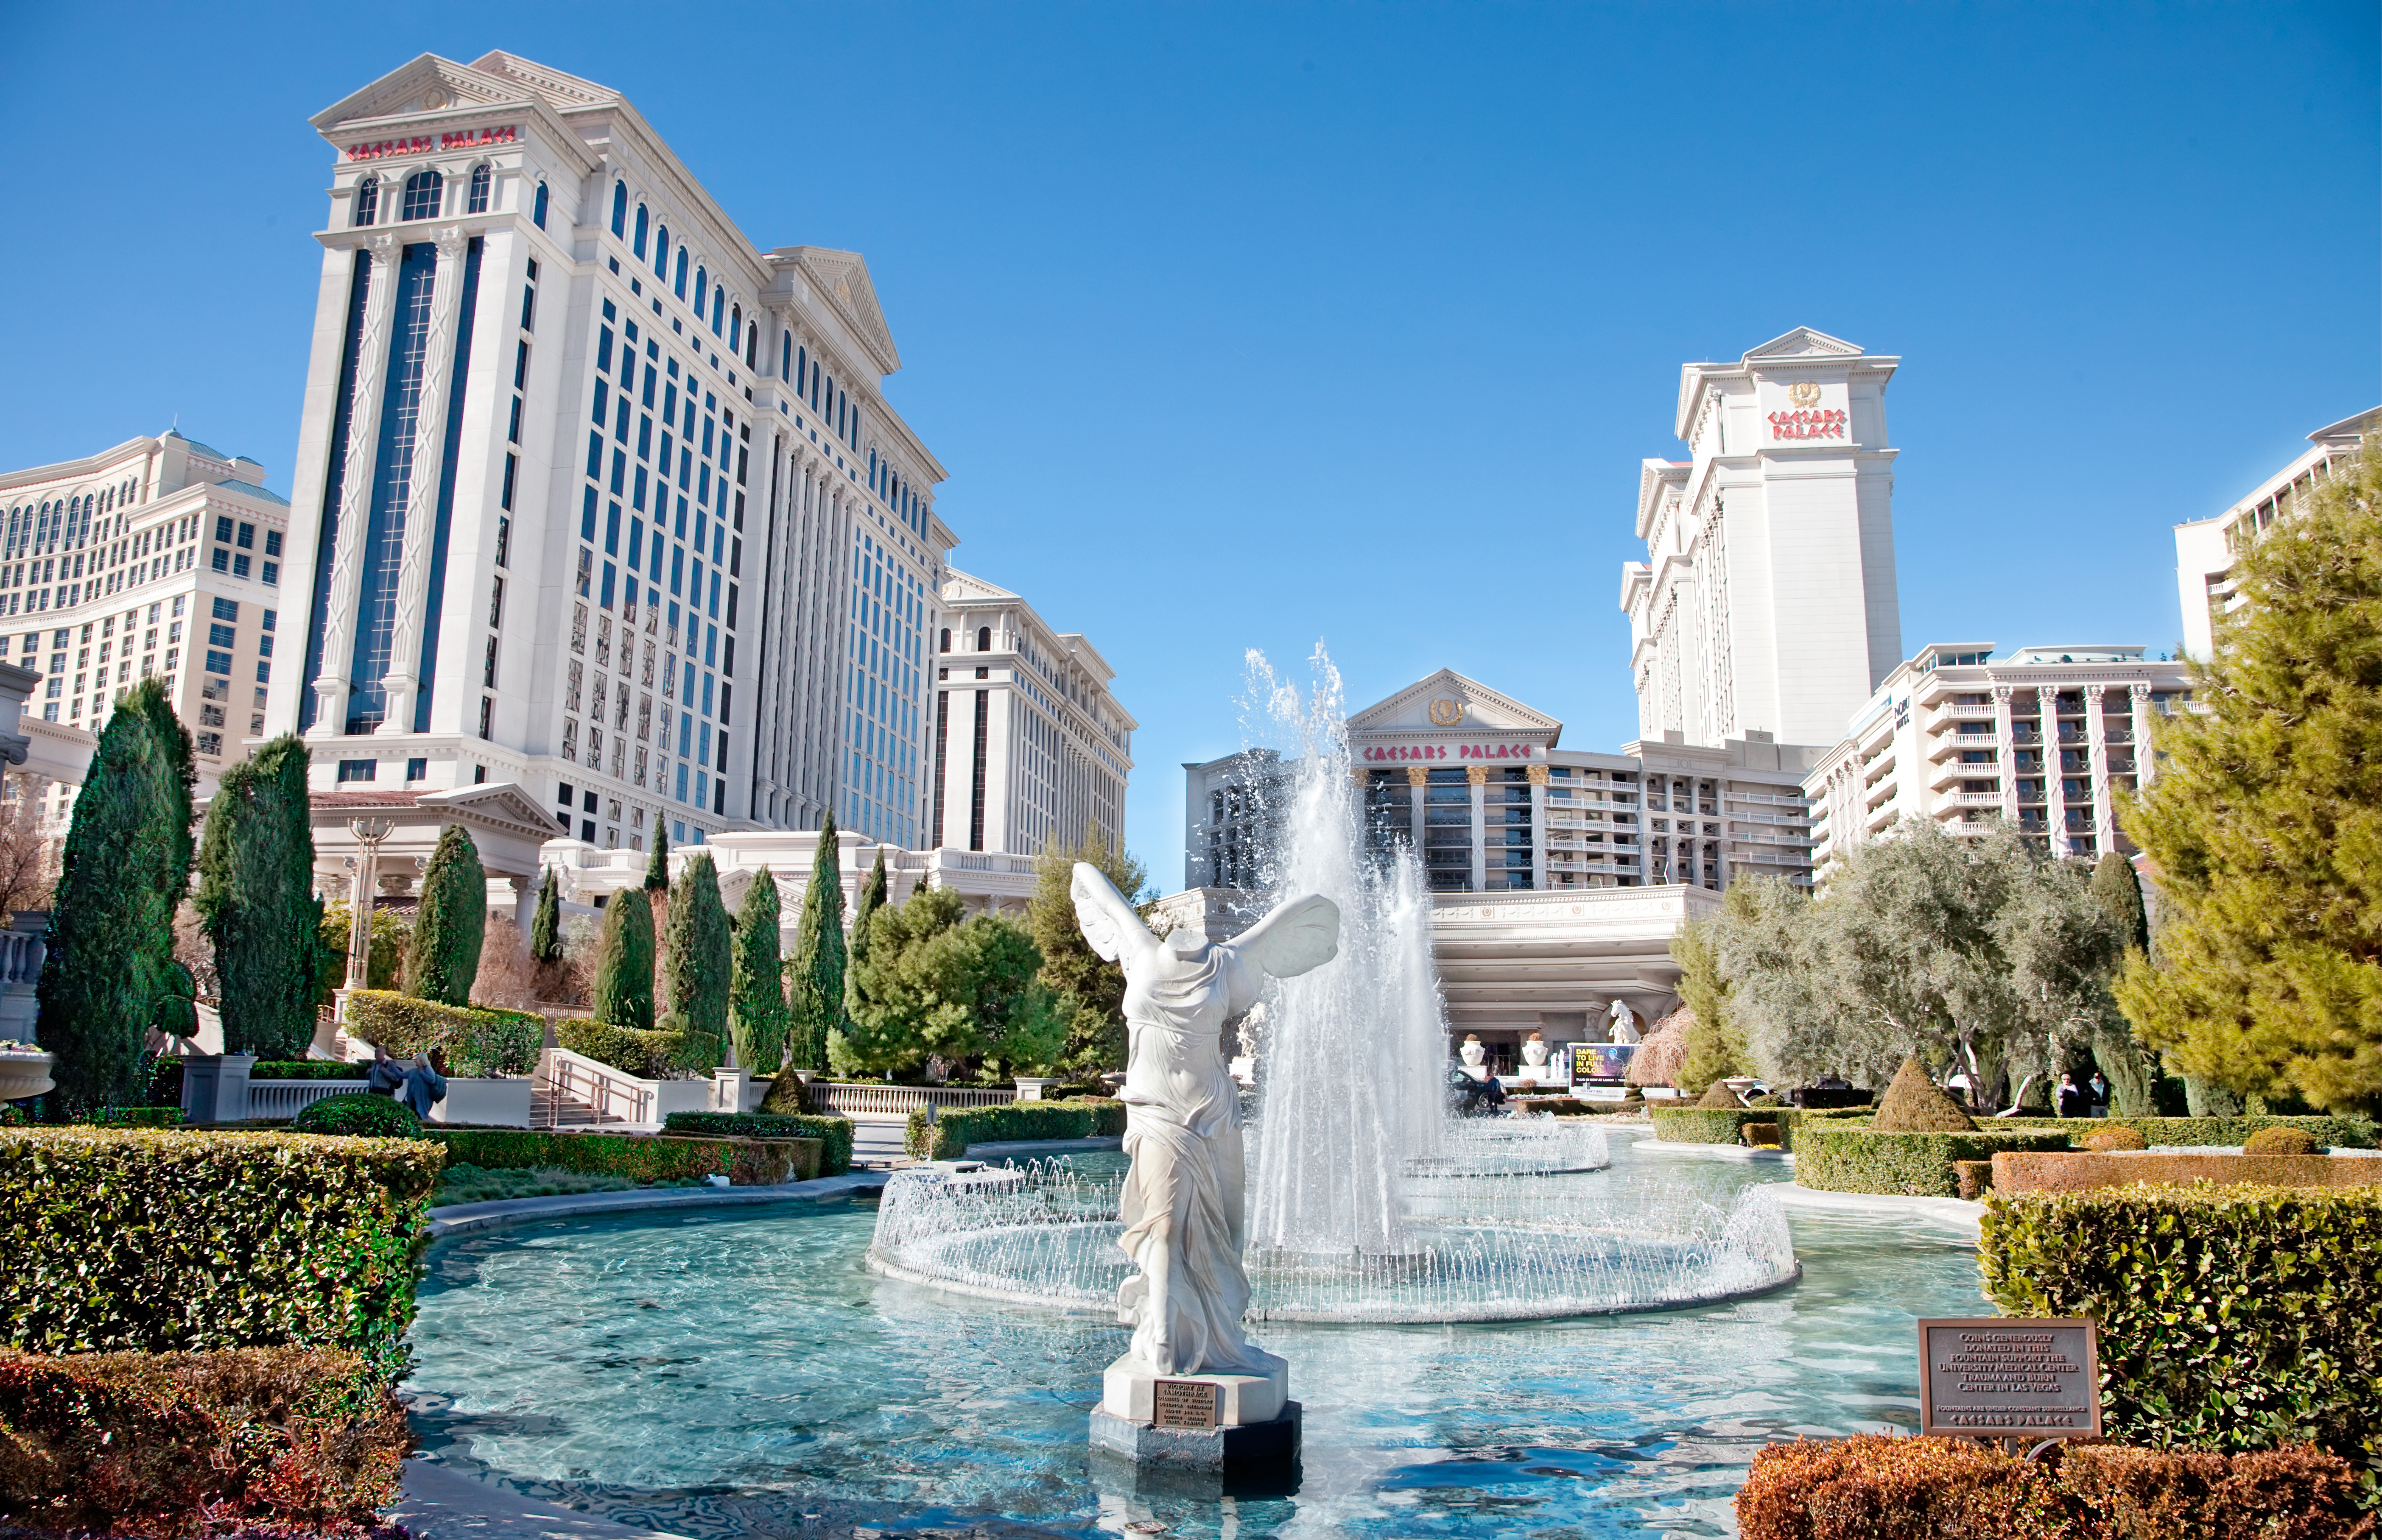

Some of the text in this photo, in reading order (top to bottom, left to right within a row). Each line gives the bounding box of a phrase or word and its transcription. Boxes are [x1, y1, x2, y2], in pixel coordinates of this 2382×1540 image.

[346, 126, 516, 162] CAESARS PALACE
[1767, 409, 1845, 425] CAESARS
[1773, 423, 1843, 439] PALACE
[1894, 695, 1910, 719] NOBU
[1364, 744, 1531, 762] CAESARS PALACE
[1992, 1334, 2054, 1343] GENEROUSLY
[1965, 1344, 2050, 1353] DONATED IN THIS
[1950, 1354, 2066, 1362] FOUNTAIN SUPPORT THE
[1938, 1362, 2080, 1373] UNIVERSITY MEDICAL CENTER
[1961, 1373, 2002, 1381] TRAUMA
[2026, 1373, 2055, 1382] BURN
[1957, 1382, 2062, 1392] CENTER IN LAS VEGAS
[1163, 1389, 1208, 1398] SAMOTHRACE
[1950, 1414, 2073, 1426] CAESARS PALACE
